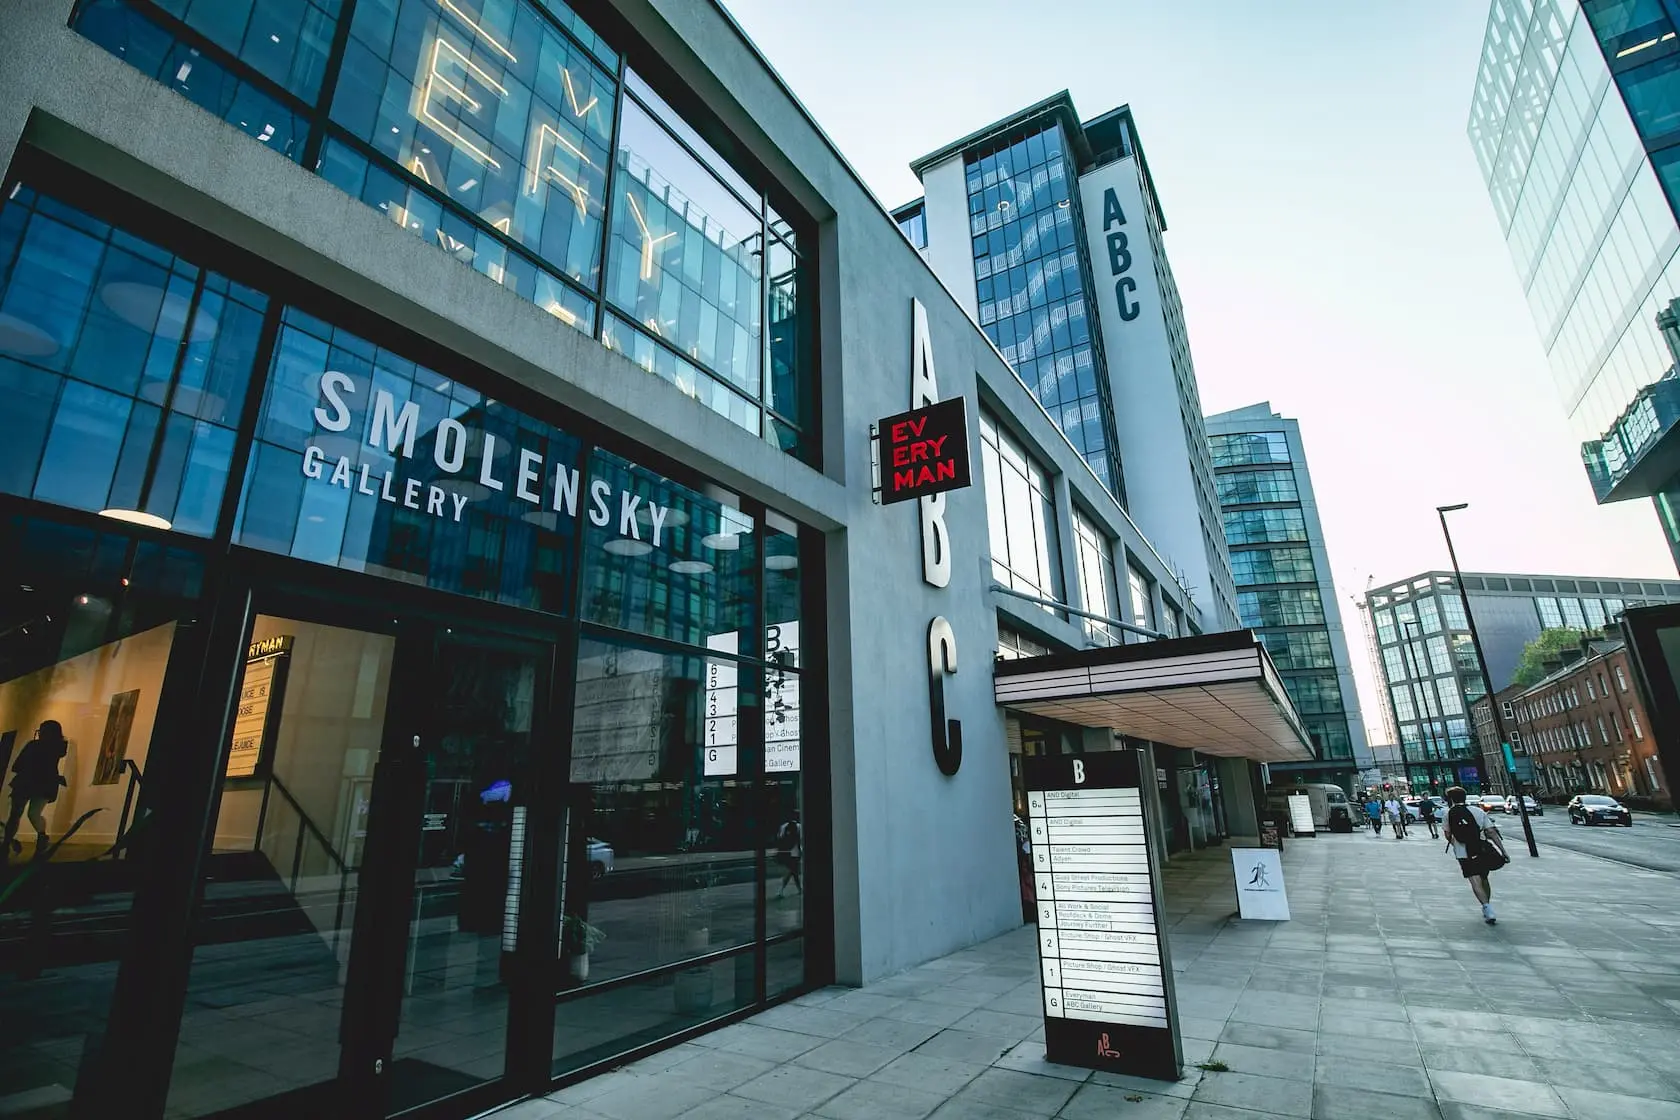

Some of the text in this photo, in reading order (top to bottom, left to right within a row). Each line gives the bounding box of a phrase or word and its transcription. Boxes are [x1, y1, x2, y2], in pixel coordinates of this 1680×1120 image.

[1103, 187, 1140, 321] ABC
[892, 416, 927, 443] EV
[893, 434, 948, 467] ERY
[314, 371, 668, 547] SMOLENSKY
[894, 459, 955, 491] MAN
[303, 446, 468, 522] GALLERY
[711, 664, 718, 675] 6
[710, 676, 717, 688] 5
[710, 691, 717, 703] 4
[710, 704, 717, 716] 3
[710, 720, 716, 732] 2
[709, 749, 717, 761] G
[769, 759, 793, 767] Gallery
[1073, 759, 1085, 784] B
[1061, 791, 1080, 799] Digital
[1036, 826, 1042, 835] 6
[1039, 854, 1044, 863] 5
[1041, 882, 1047, 890] 4
[1044, 910, 1050, 918] 3
[1047, 938, 1052, 947] 2
[1051, 991, 1096, 1007] G Everyman
[1080, 1002, 1103, 1012] Gallery
